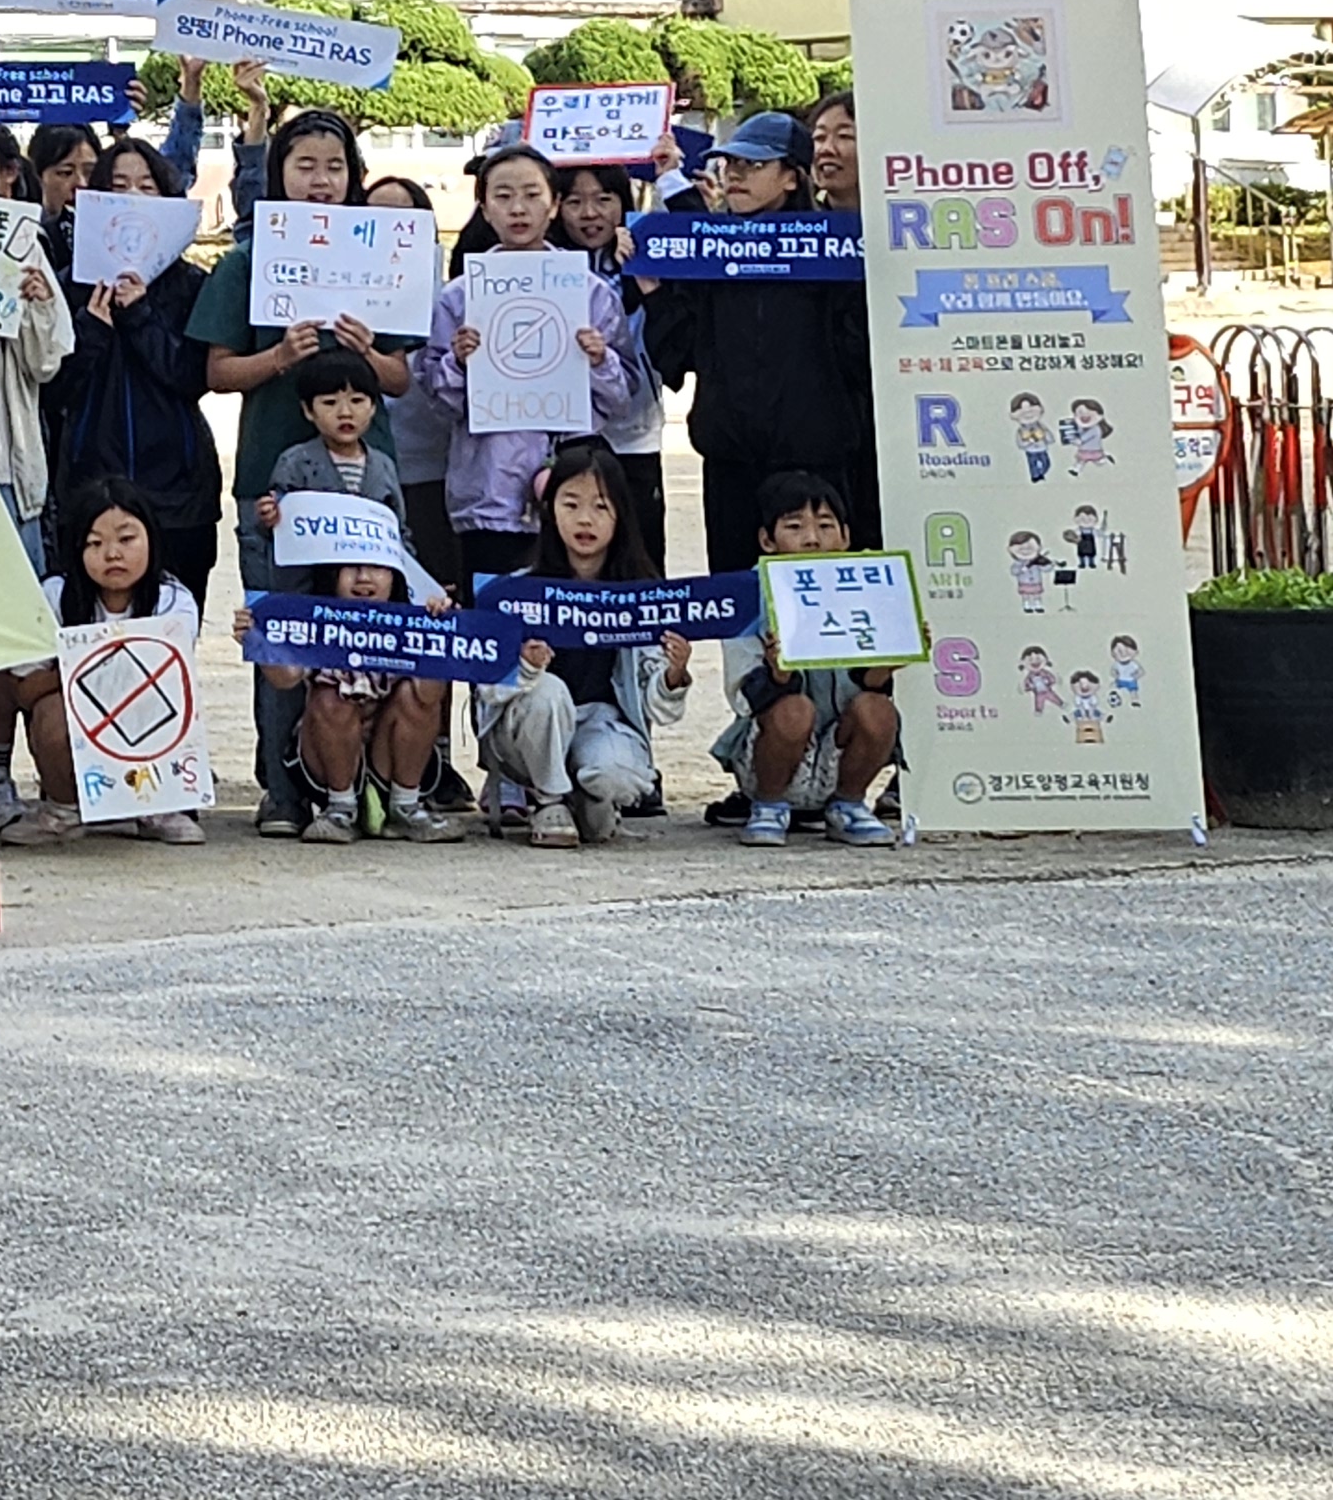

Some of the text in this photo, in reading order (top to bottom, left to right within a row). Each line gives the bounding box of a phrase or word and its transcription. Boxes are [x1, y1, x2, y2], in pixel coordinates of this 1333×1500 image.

[223, 24, 283, 50] Phone
[287, 34, 325, 59] 끄고
[329, 42, 372, 66] RAS
[28, 85, 66, 105] 끄고
[71, 85, 114, 103] RAS
[885, 150, 1102, 188] Phone Off,
[887, 194, 1135, 250] RAS On!
[702, 239, 818, 258] Phone 끄고
[469, 260, 585, 300] Phone Free
[474, 392, 582, 426] SCHOOL
[919, 452, 991, 467] Reading
[793, 564, 894, 607] 폰 프리
[556, 599, 736, 628] Phone 끄고 RAS
[818, 610, 877, 651] 스쿨
[323, 624, 498, 661] Phone 끄고 RAS
[988, 773, 1150, 791] 경기도양평교육지원청
